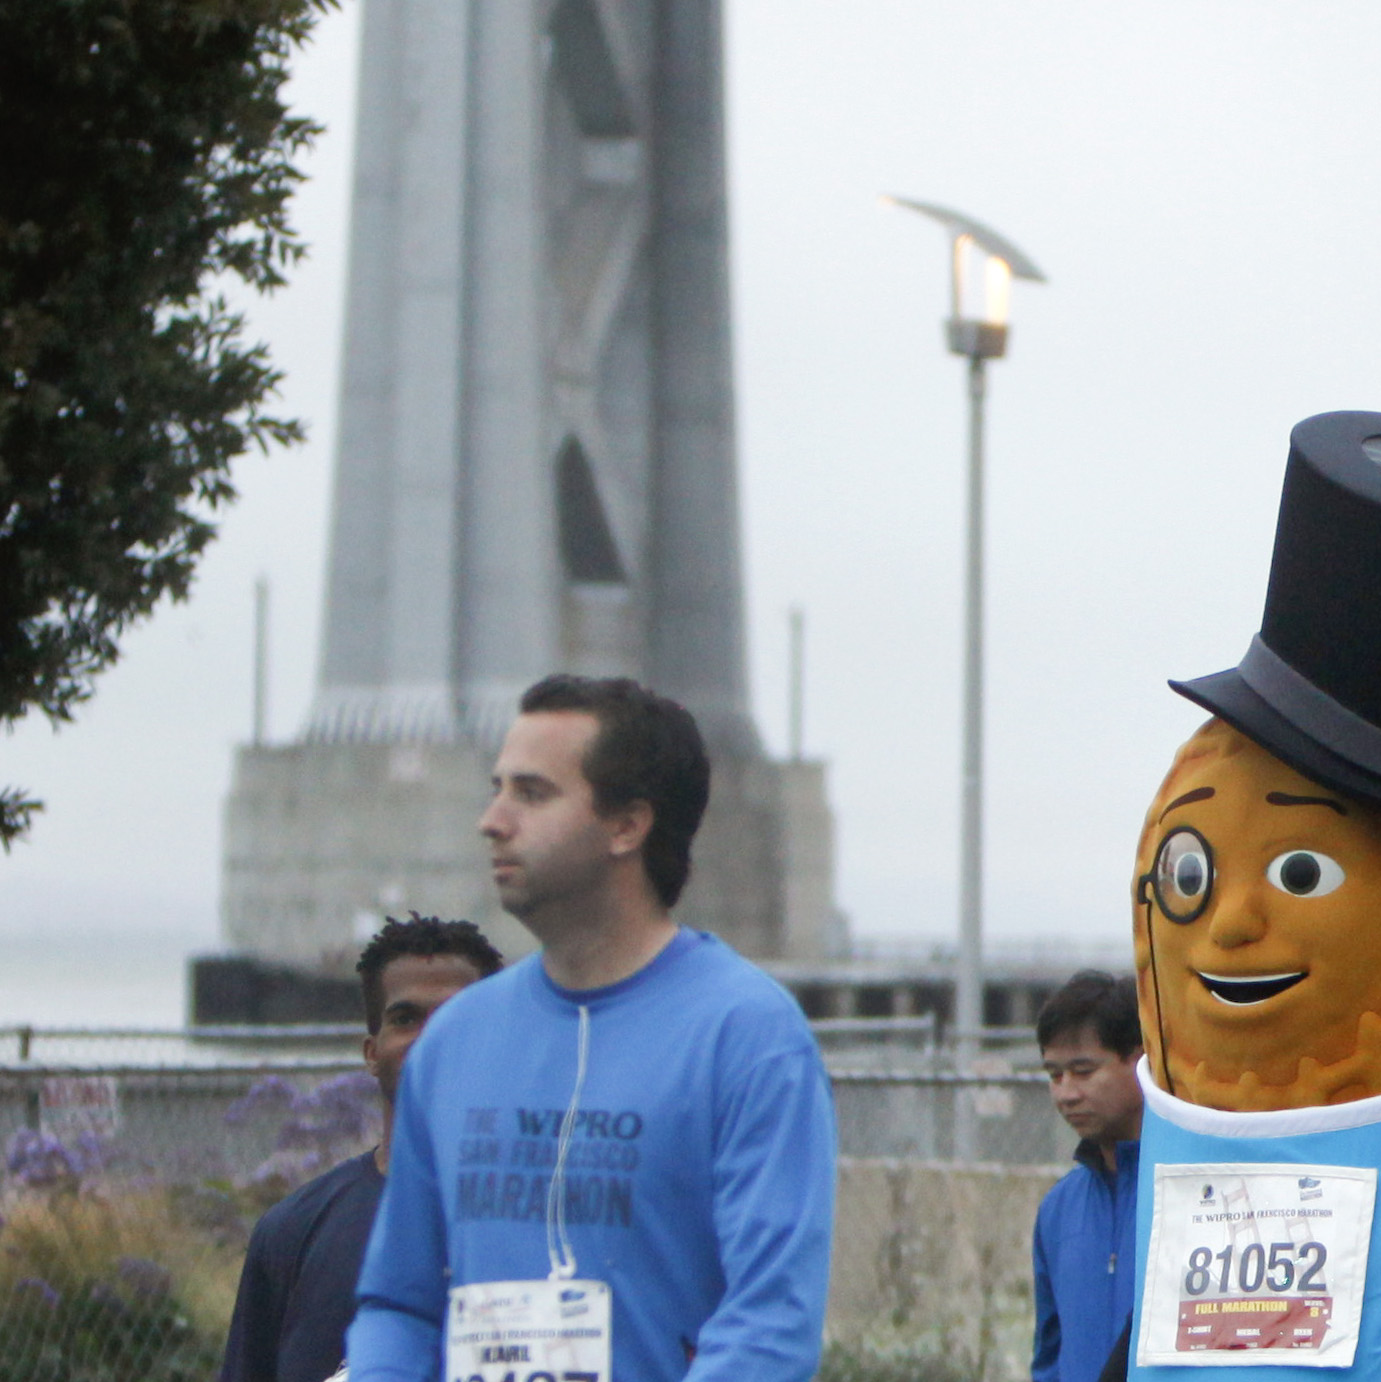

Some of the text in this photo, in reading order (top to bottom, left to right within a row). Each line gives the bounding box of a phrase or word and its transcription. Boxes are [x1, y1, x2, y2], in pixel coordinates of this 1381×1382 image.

[1192, 1214, 1203, 1223] THE
[1206, 1213, 1241, 1222] WIPRO
[1256, 1208, 1296, 1219] FRANCISCO
[1298, 1208, 1333, 1218] MARATHON
[1185, 1241, 1327, 1296] 81052
[1195, 1301, 1287, 1315] FULL MARATHON
